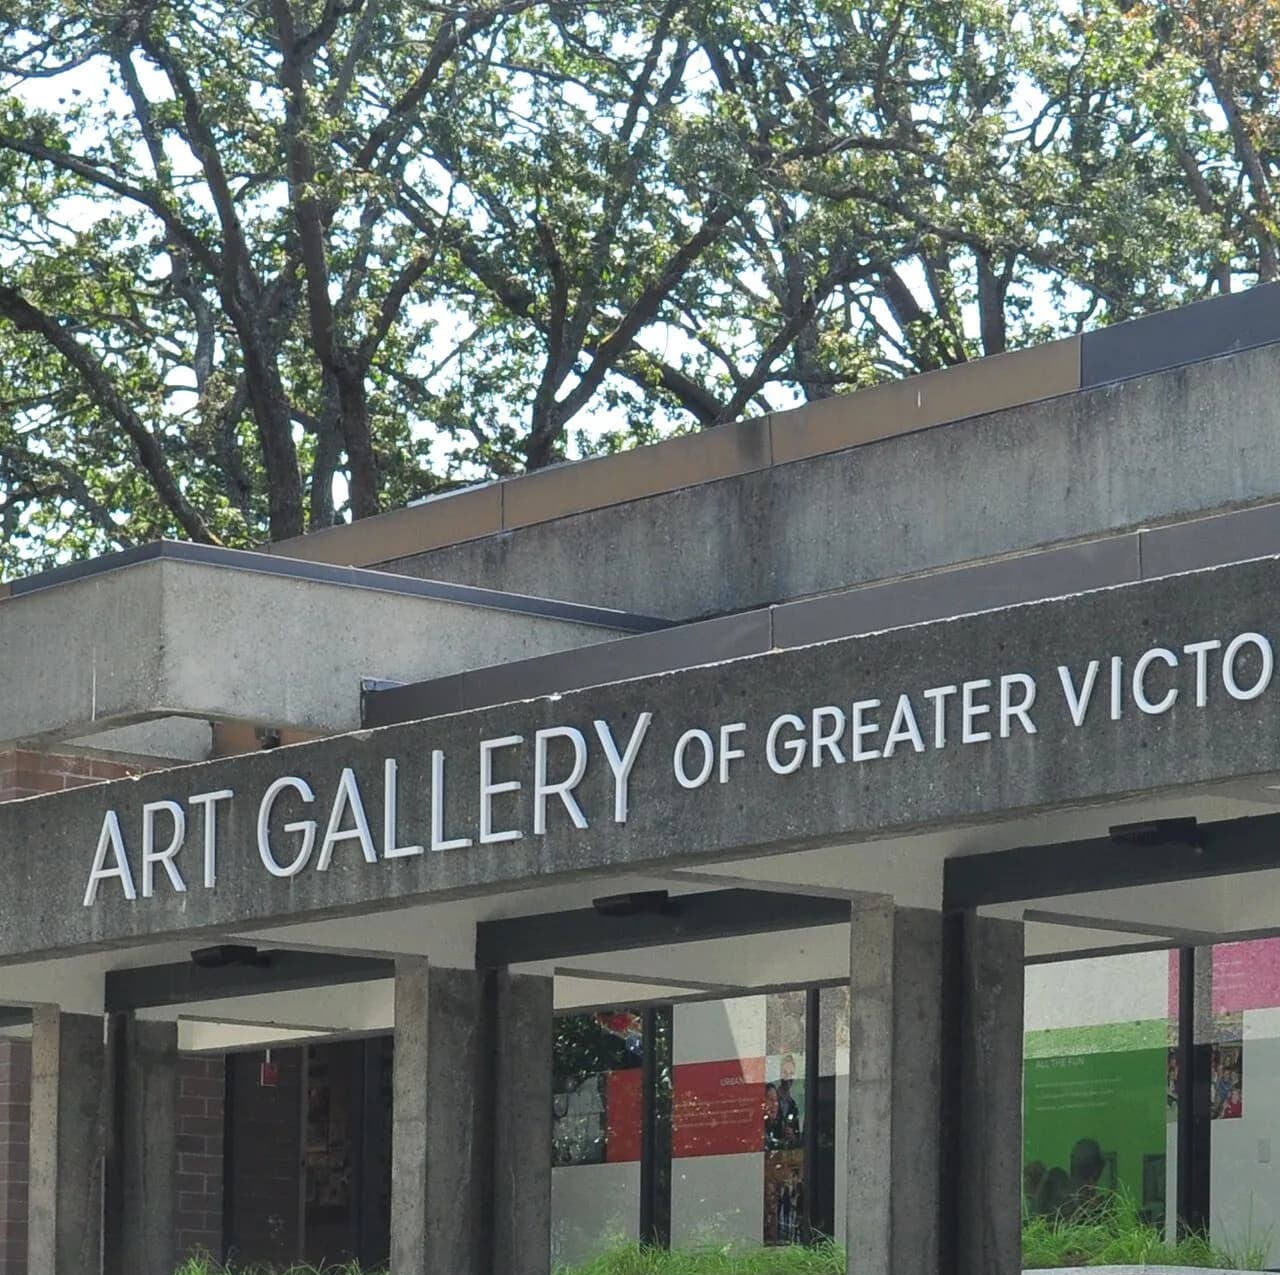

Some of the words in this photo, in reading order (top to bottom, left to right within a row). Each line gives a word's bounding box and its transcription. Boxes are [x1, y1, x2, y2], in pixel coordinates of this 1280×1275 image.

[84, 789, 233, 906] ART
[257, 711, 651, 877] GALLERY
[672, 722, 746, 788] OF
[765, 672, 1038, 776] GREATER
